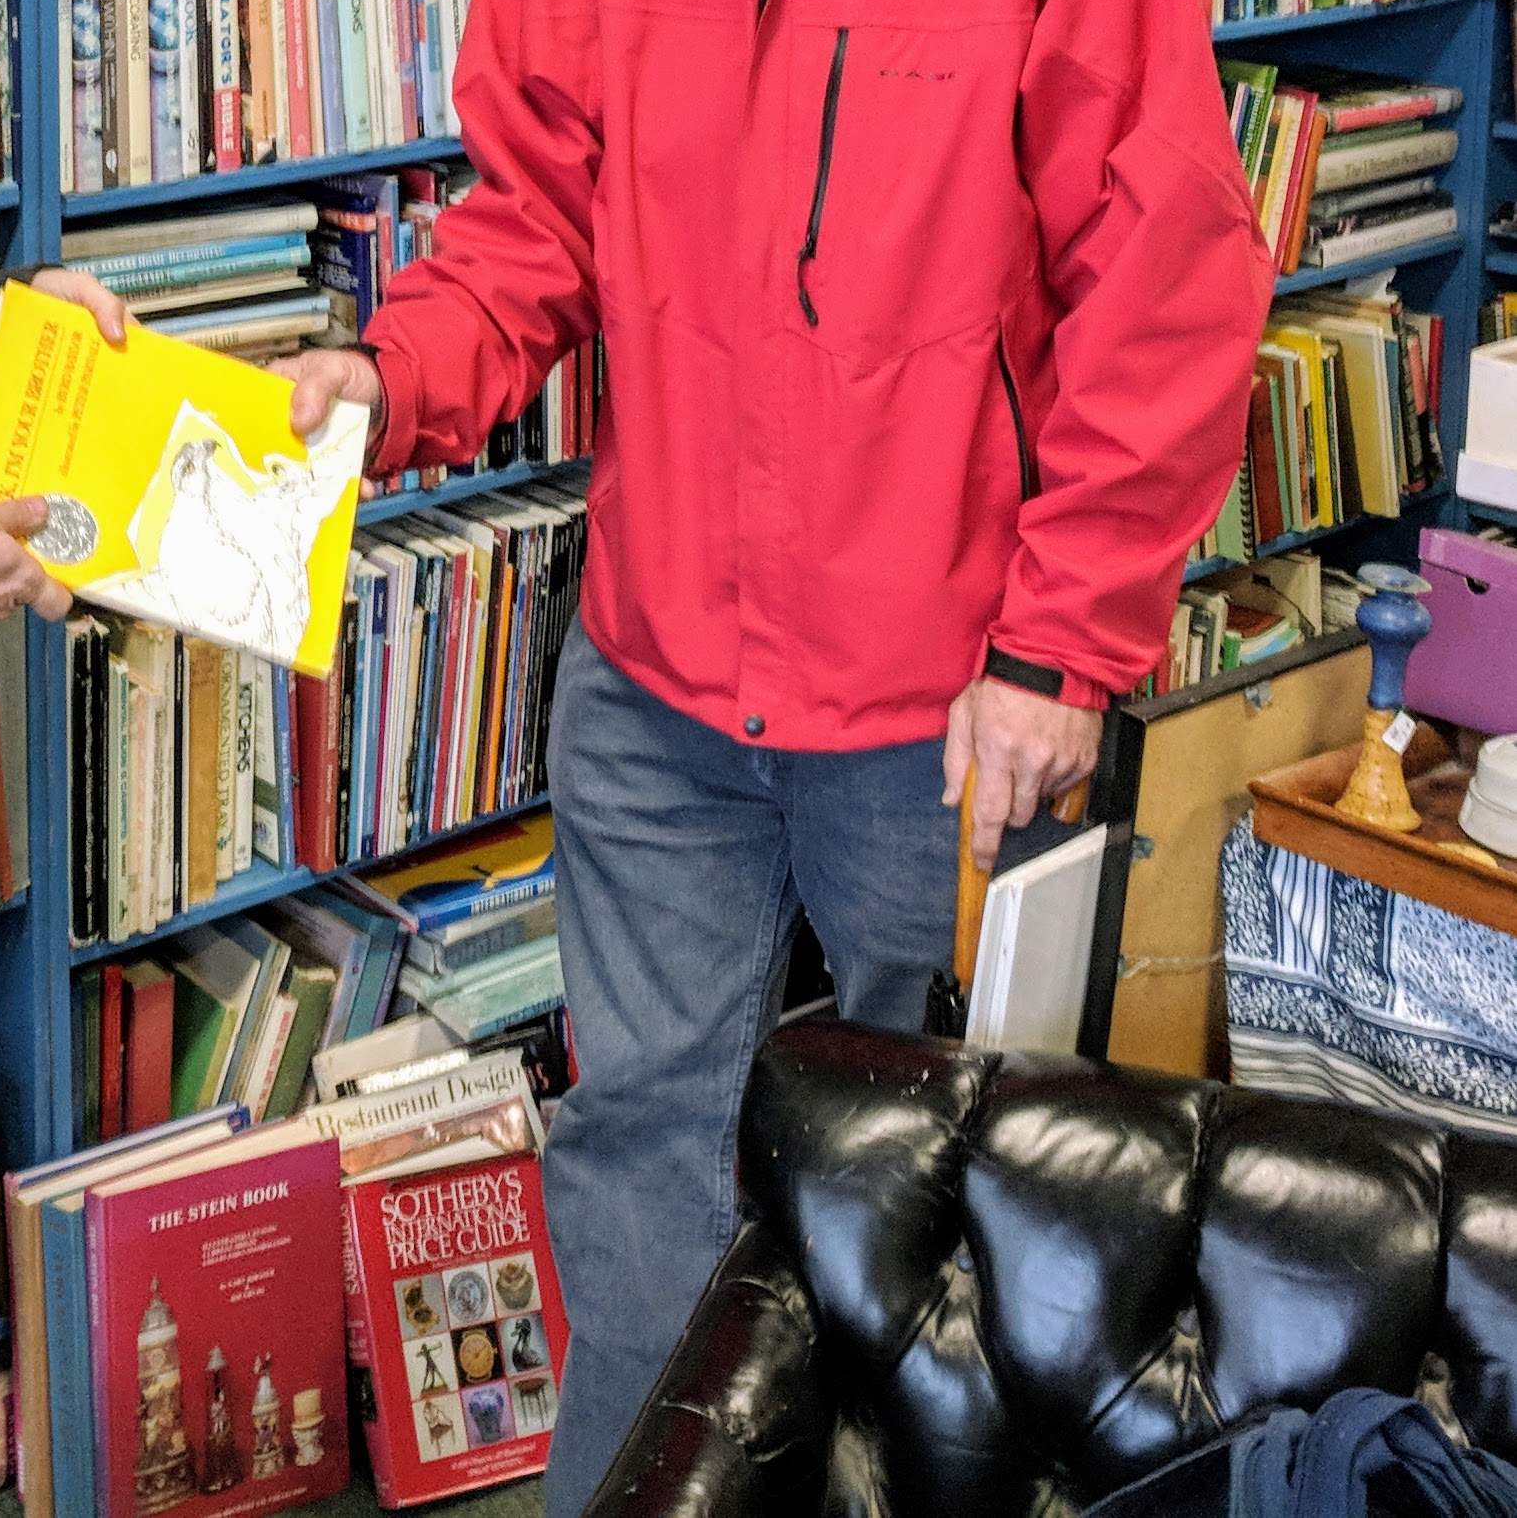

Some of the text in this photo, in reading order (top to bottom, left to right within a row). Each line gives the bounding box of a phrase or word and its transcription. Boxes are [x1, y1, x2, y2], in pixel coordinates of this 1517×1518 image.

[219, 92, 234, 151] BIBLE
[237, 683, 251, 773] KITCHENS
[315, 1066, 523, 1138] Restaurant Design
[148, 1181, 290, 1233] THE STEIN BOOK
[380, 1168, 523, 1226] SOTHEBY'S
[385, 1199, 526, 1245] INTERNATIONAL
[389, 1222, 531, 1270] PRICE GUIDE
